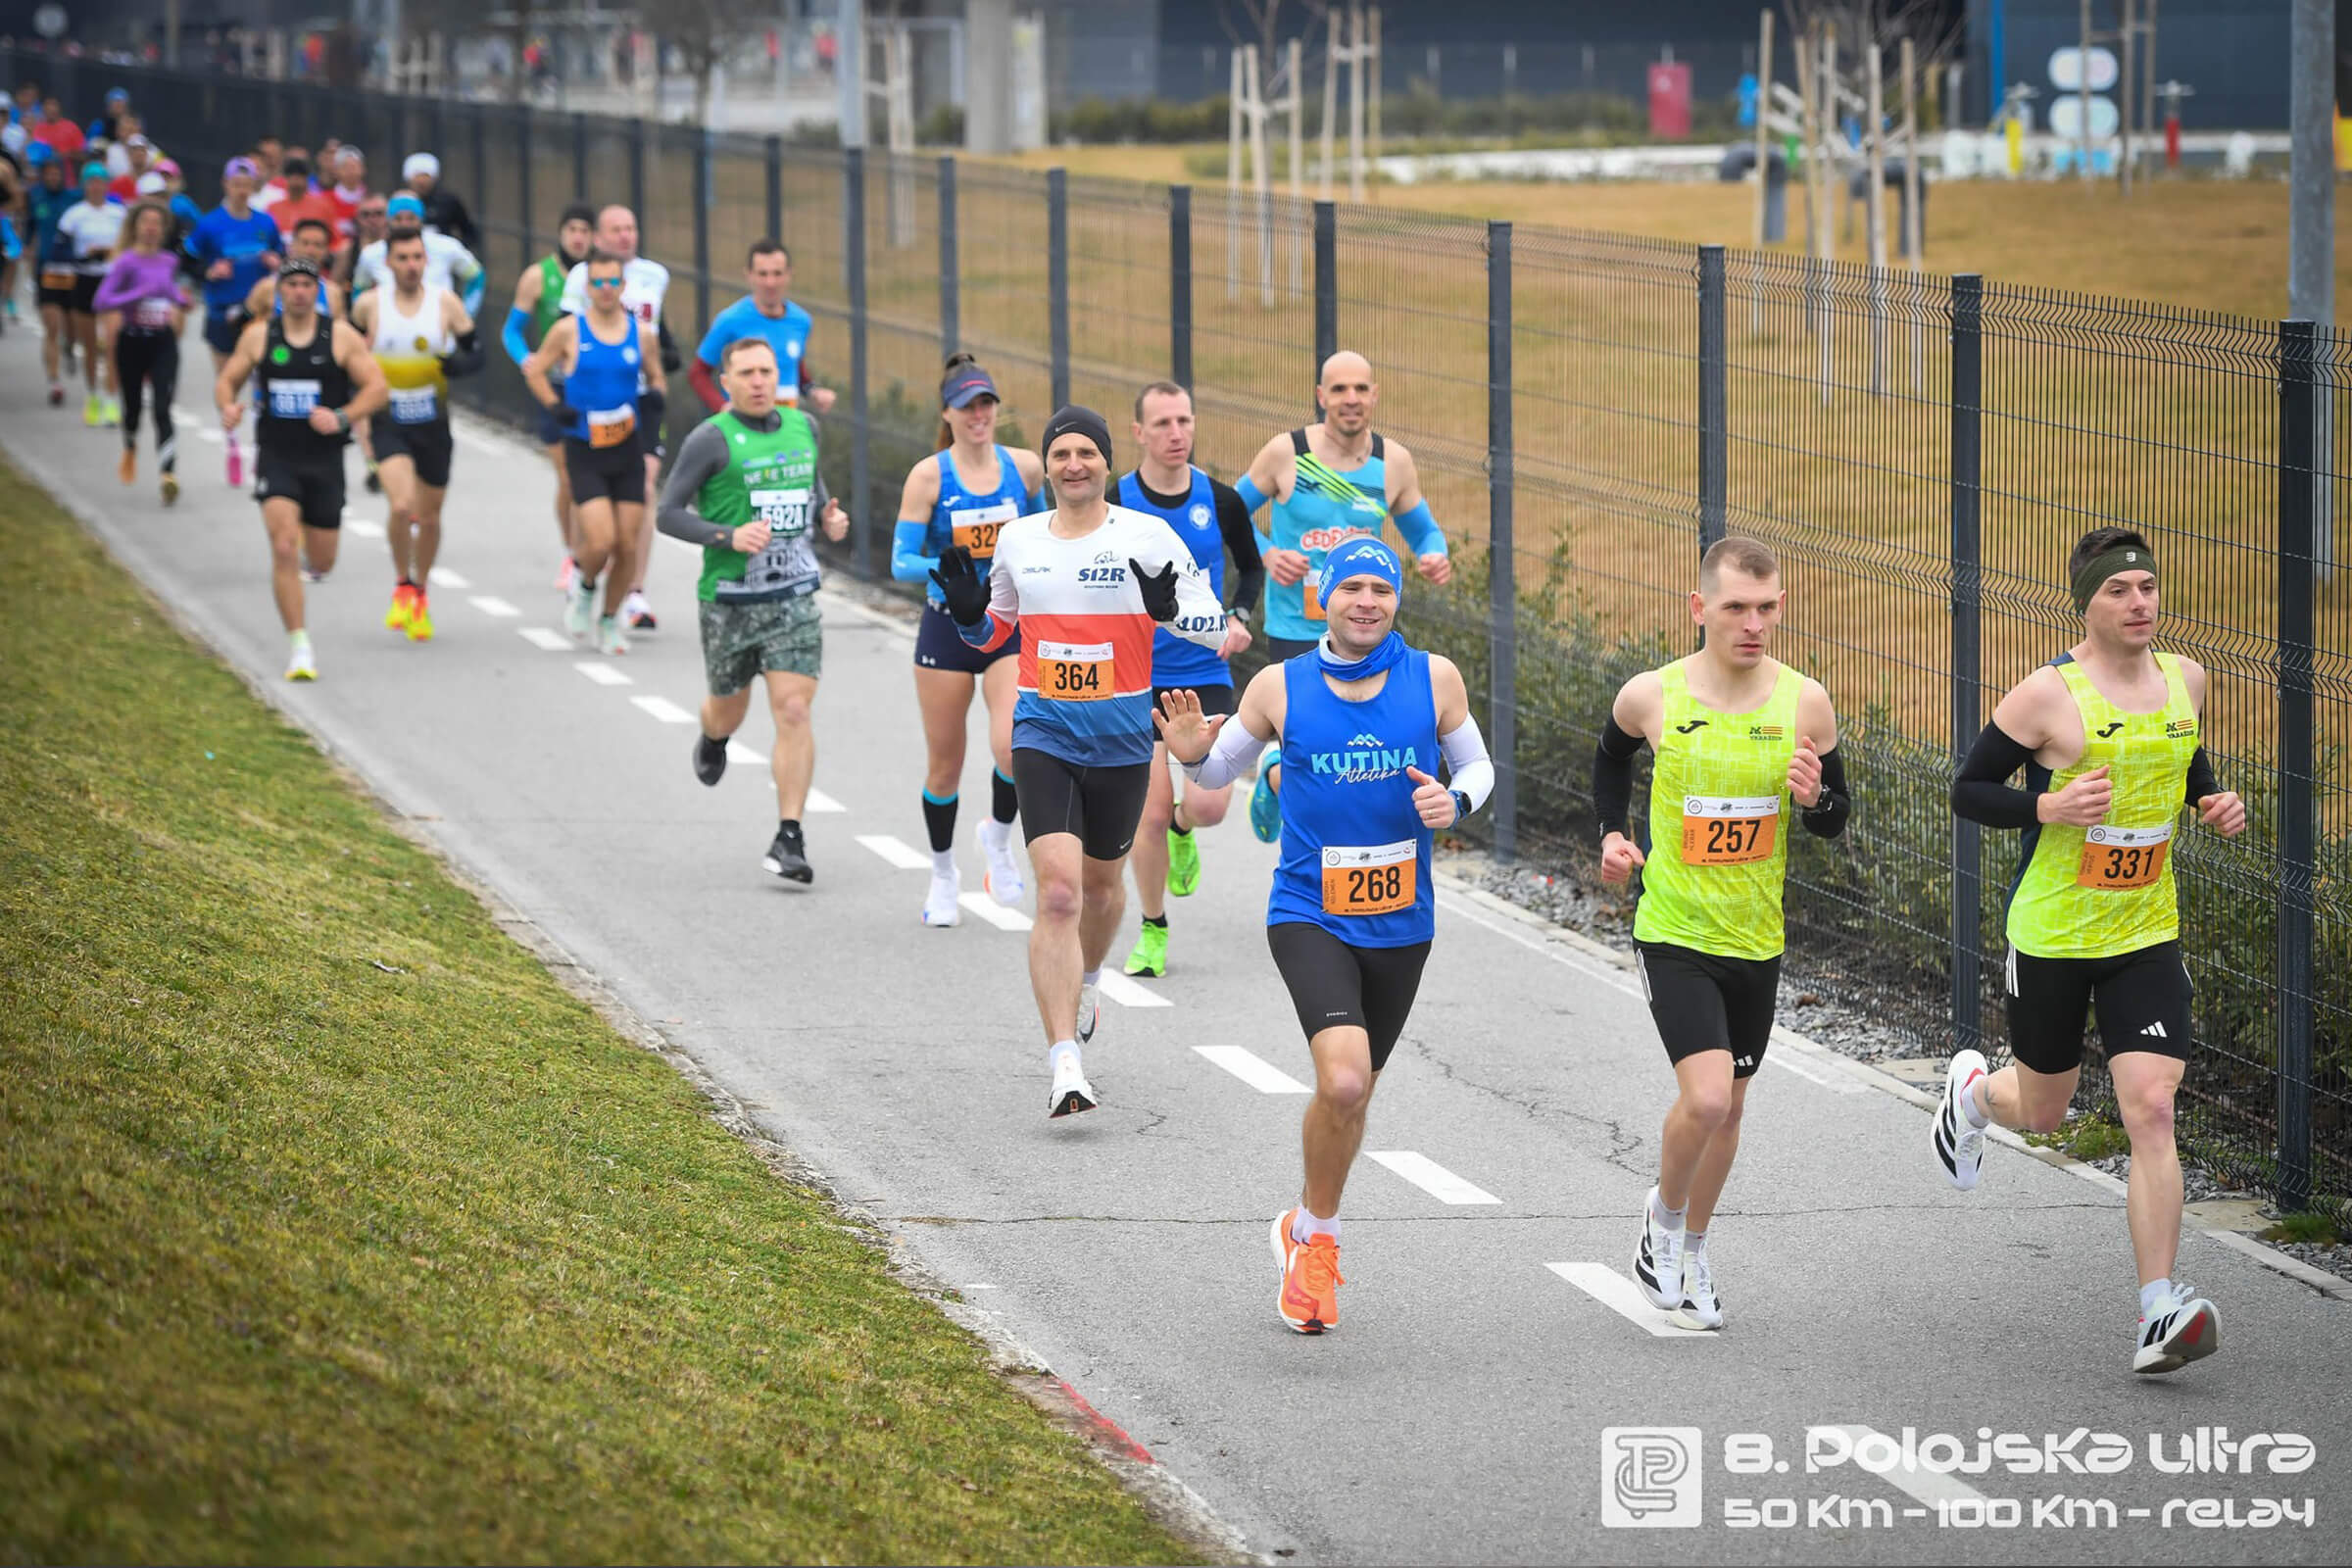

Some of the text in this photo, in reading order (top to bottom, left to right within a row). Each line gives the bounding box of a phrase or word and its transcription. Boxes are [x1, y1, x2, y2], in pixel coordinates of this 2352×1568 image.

[1054, 662, 1099, 691] 364
[1311, 747, 1418, 774] KUTINA
[1334, 767, 1400, 785] Atletika
[1707, 818, 1761, 853] 257
[2104, 847, 2155, 880] 331
[1348, 866, 1400, 903] 268
